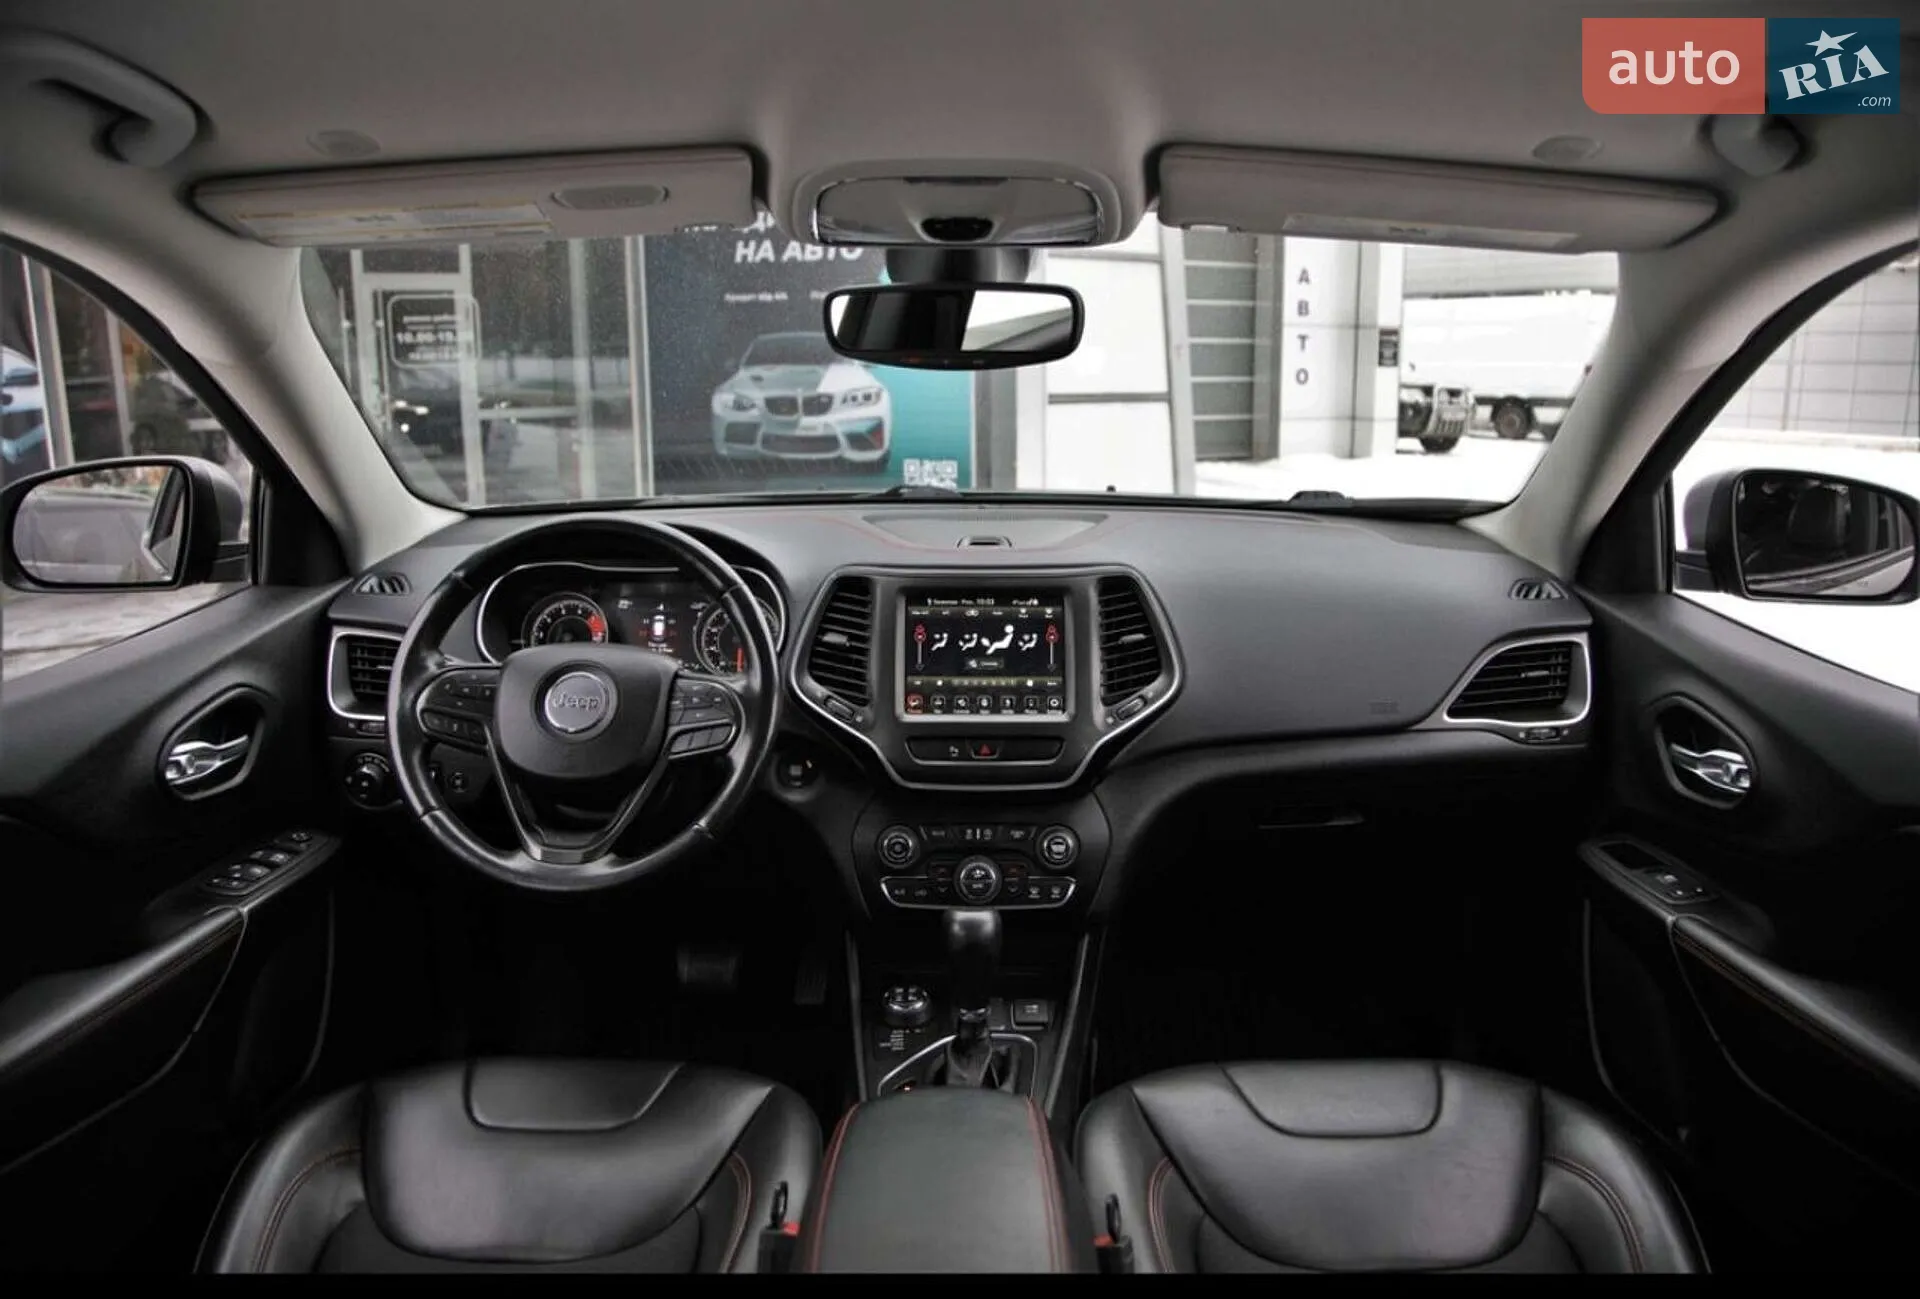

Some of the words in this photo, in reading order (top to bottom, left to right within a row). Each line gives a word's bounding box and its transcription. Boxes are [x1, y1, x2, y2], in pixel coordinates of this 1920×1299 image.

[734, 239, 775, 263] НА
[1295, 267, 1311, 386] АВТО
[558, 691, 599, 711] Jeep
